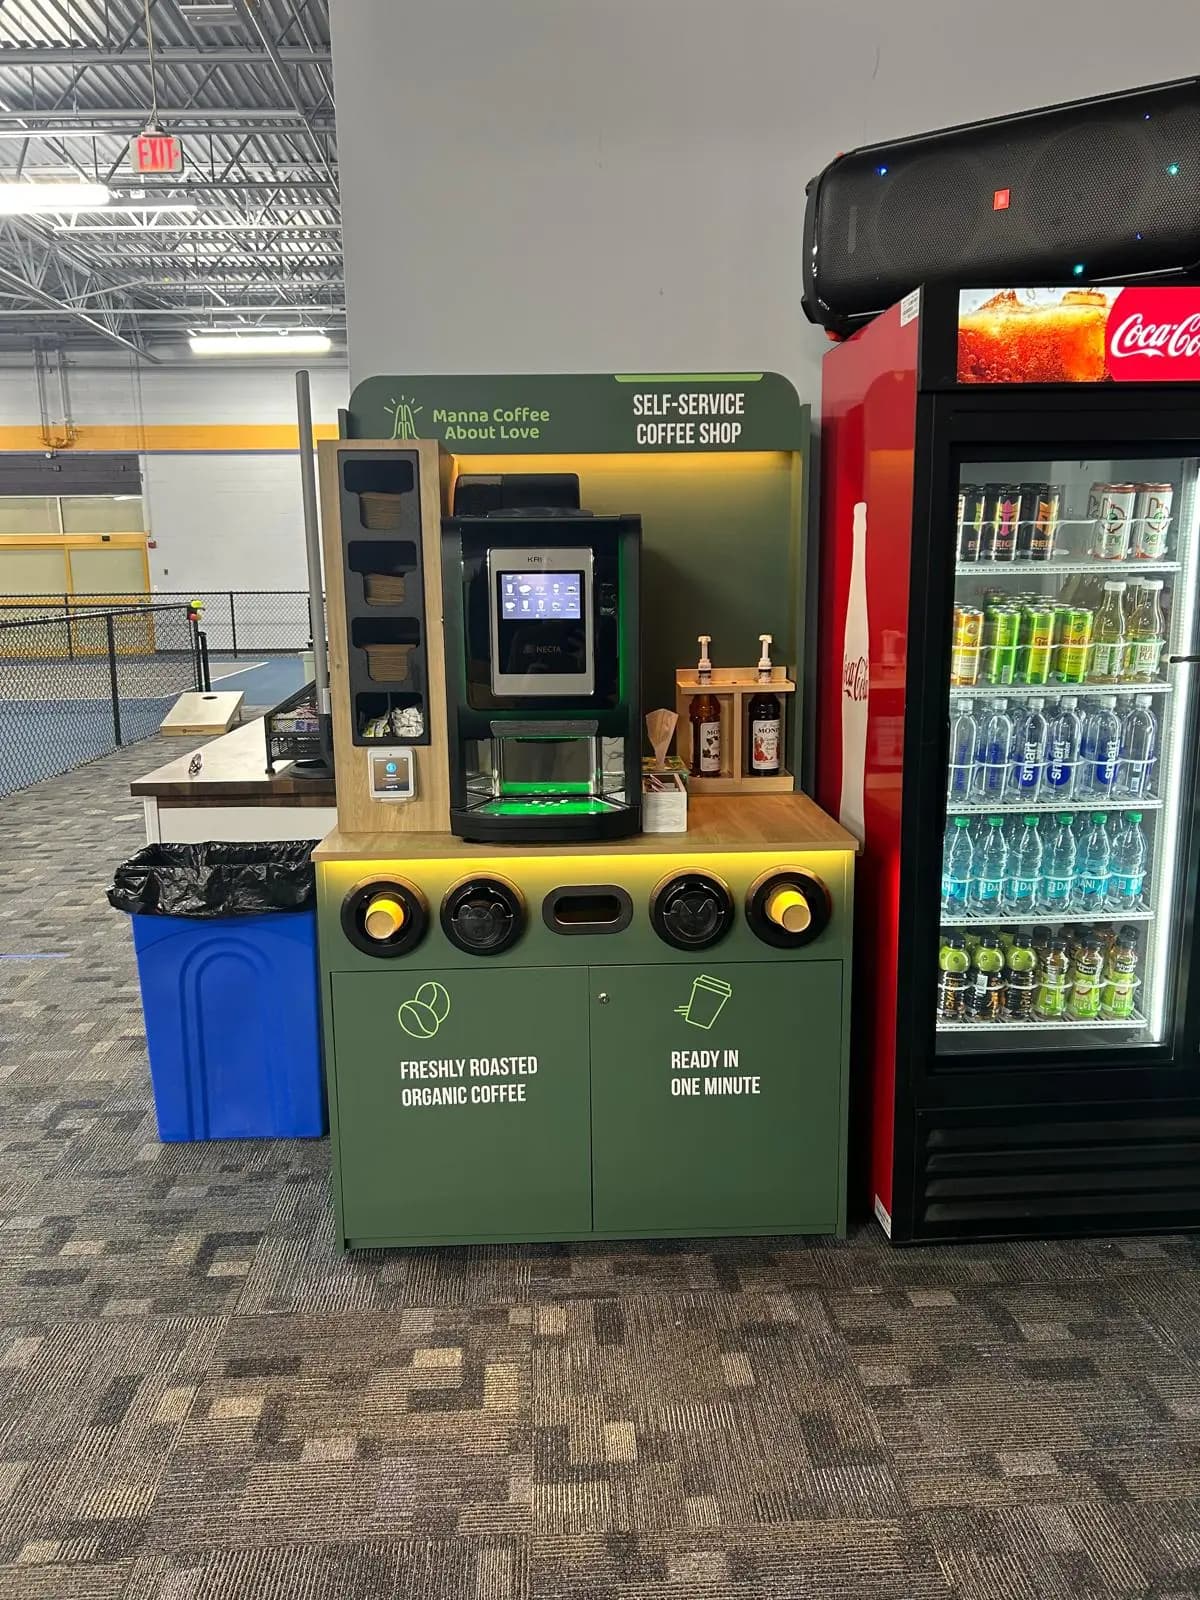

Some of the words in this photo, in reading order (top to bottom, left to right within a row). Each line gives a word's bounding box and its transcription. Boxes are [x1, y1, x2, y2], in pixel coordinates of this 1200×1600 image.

[137, 138, 174, 170] EXIT
[433, 409, 489, 423] Manna
[493, 407, 550, 422] Coffee
[633, 393, 745, 416] SELF-SERVICE
[445, 425, 496, 440] About
[500, 425, 541, 439] Love
[636, 423, 696, 444] COFFEE
[699, 422, 742, 444] SHOP
[1022, 741, 1037, 781] smart
[1051, 739, 1065, 780] smart
[1104, 739, 1118, 779] smart
[400, 1059, 466, 1079] FRESHLY
[469, 1056, 538, 1077] ROASTED
[671, 1050, 720, 1069] READY
[724, 1050, 739, 1068] IN
[402, 1086, 468, 1106] ORGANIC
[471, 1084, 526, 1104] COFFEE
[671, 1078, 701, 1096] ONE
[704, 1076, 761, 1095] MINUTE
